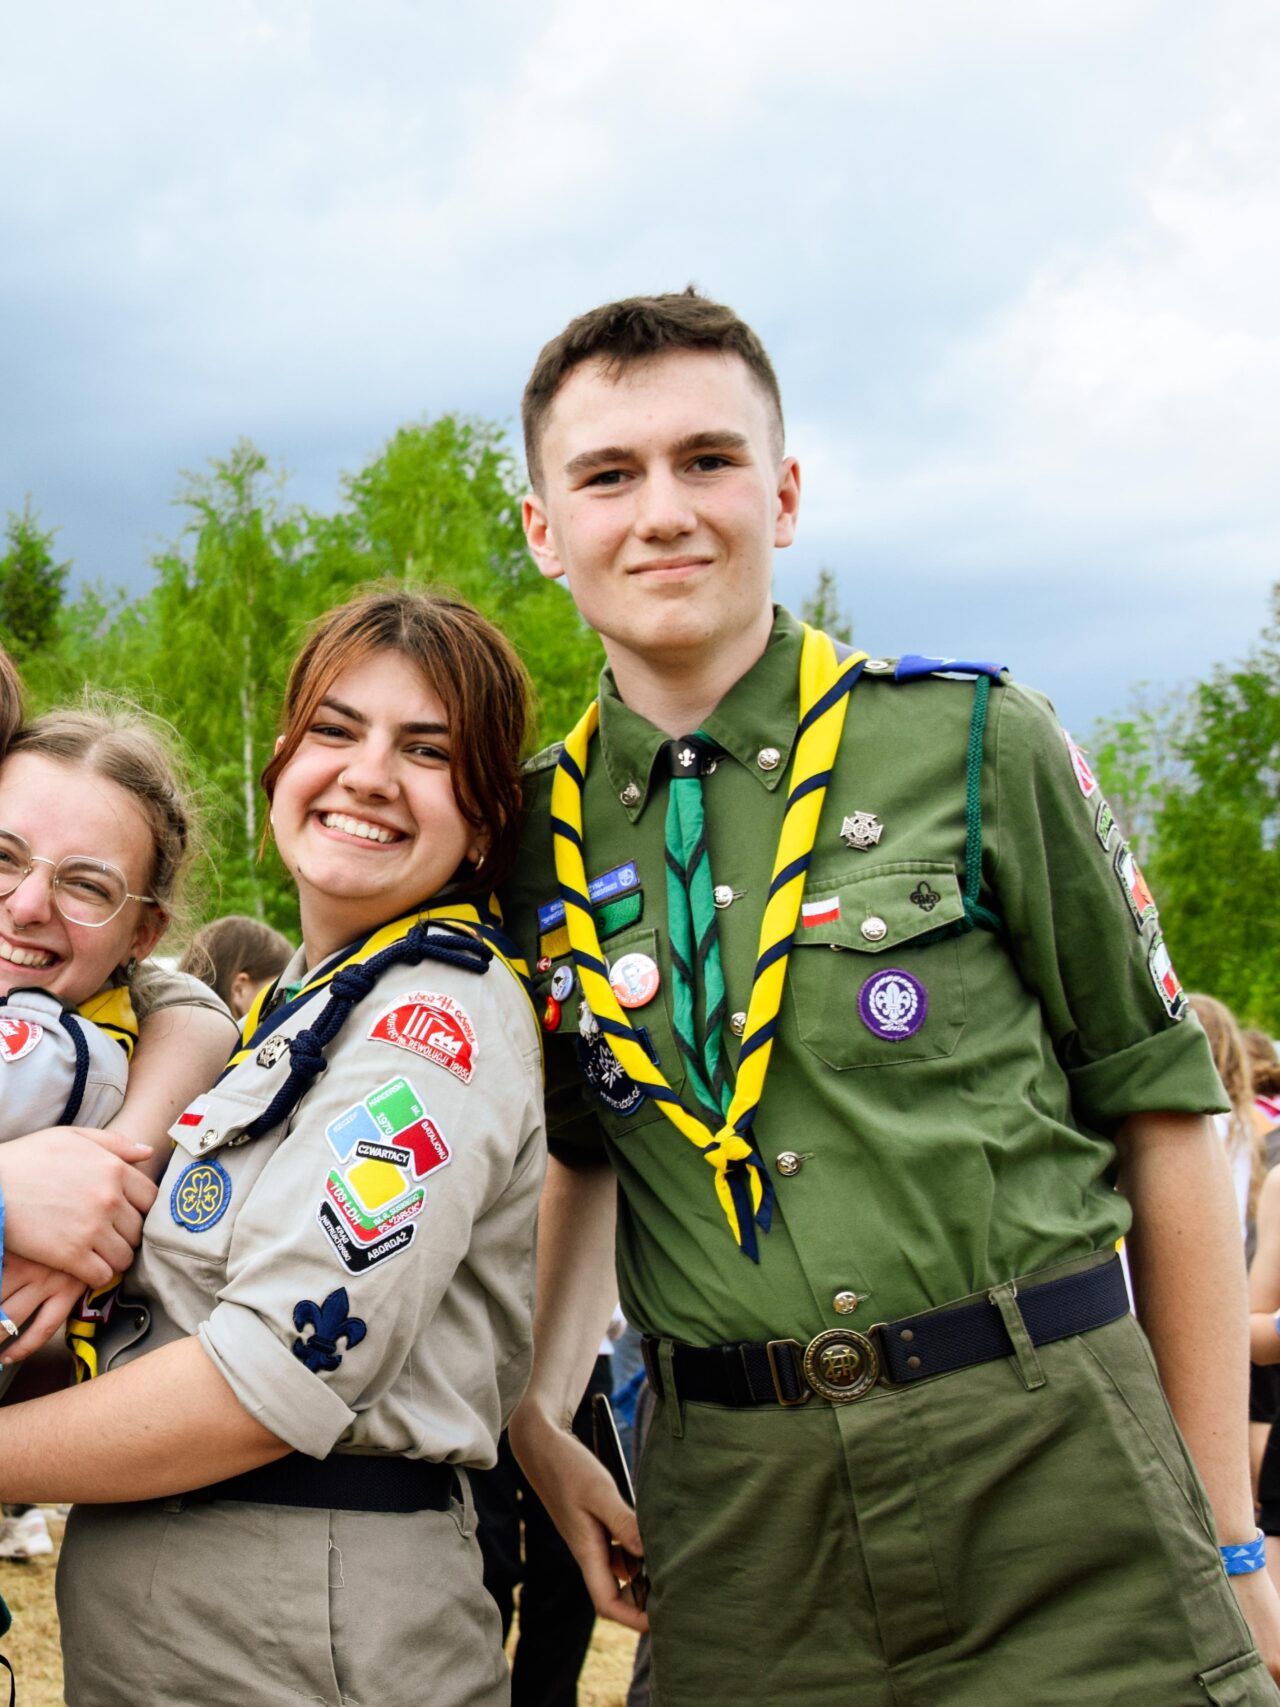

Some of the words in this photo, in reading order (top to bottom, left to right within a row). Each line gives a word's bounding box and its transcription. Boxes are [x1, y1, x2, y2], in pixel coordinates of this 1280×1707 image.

[408, 1039, 449, 1065] REWOLUCJI
[375, 1113, 395, 1135] 1970
[420, 1120, 448, 1160] BATALIONU
[357, 1144, 409, 1163] CZWARTACY
[330, 1183, 348, 1203] 103
[342, 1202, 363, 1225] ŁDH
